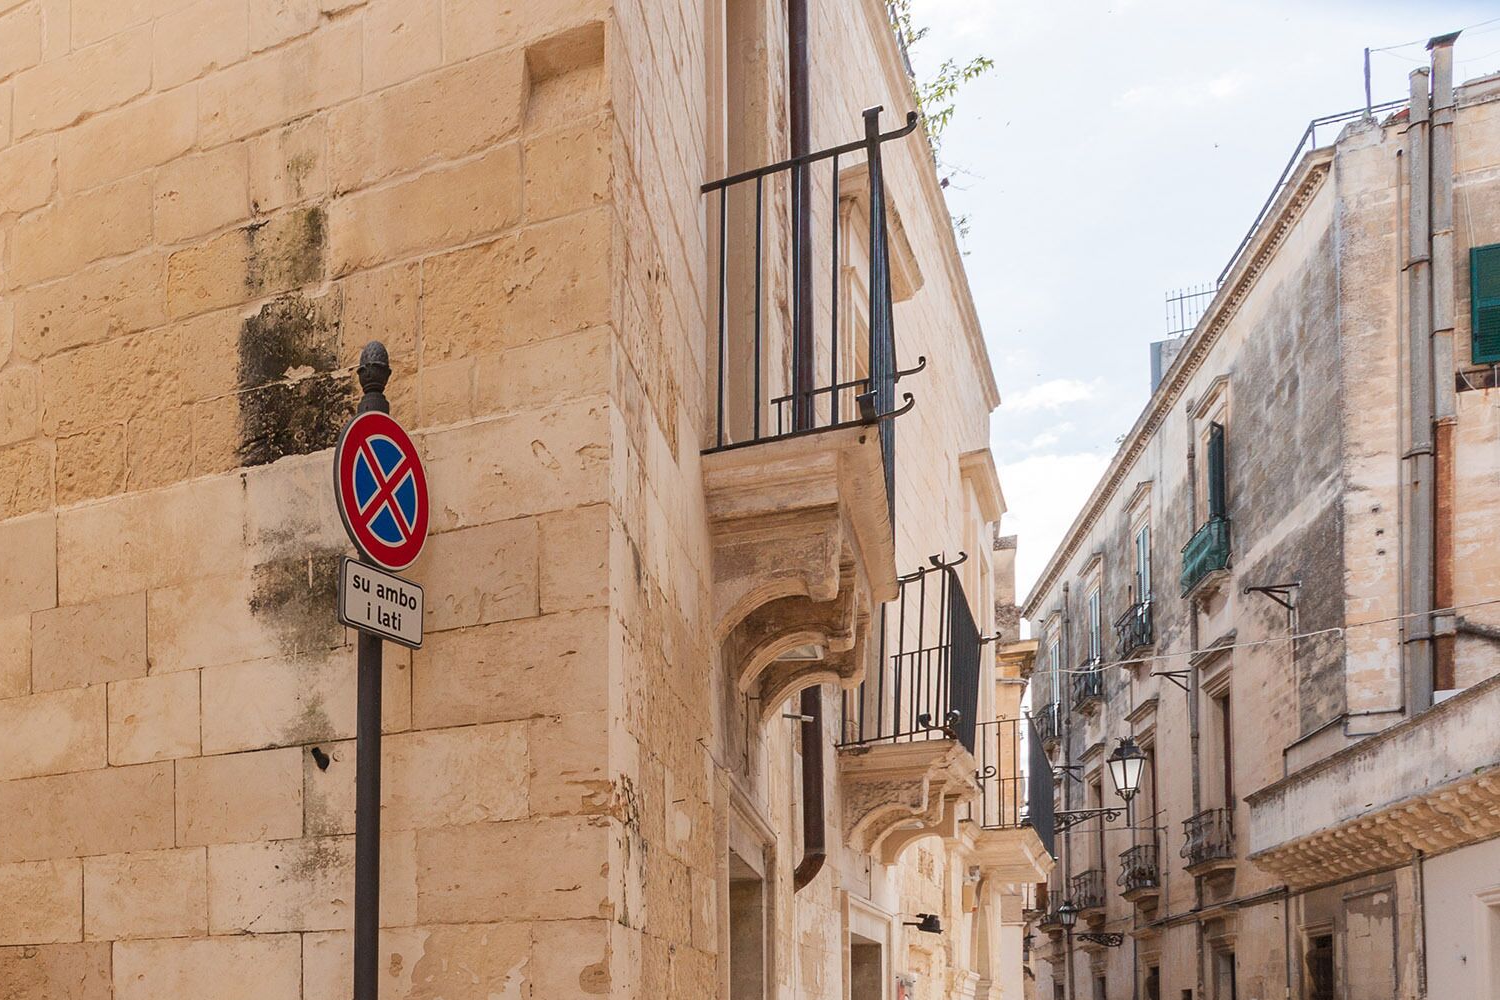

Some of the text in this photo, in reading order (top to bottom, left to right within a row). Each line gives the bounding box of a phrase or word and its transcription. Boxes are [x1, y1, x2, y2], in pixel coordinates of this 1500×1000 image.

[352, 574, 417, 611] su ambo
[377, 606, 401, 631] lati
